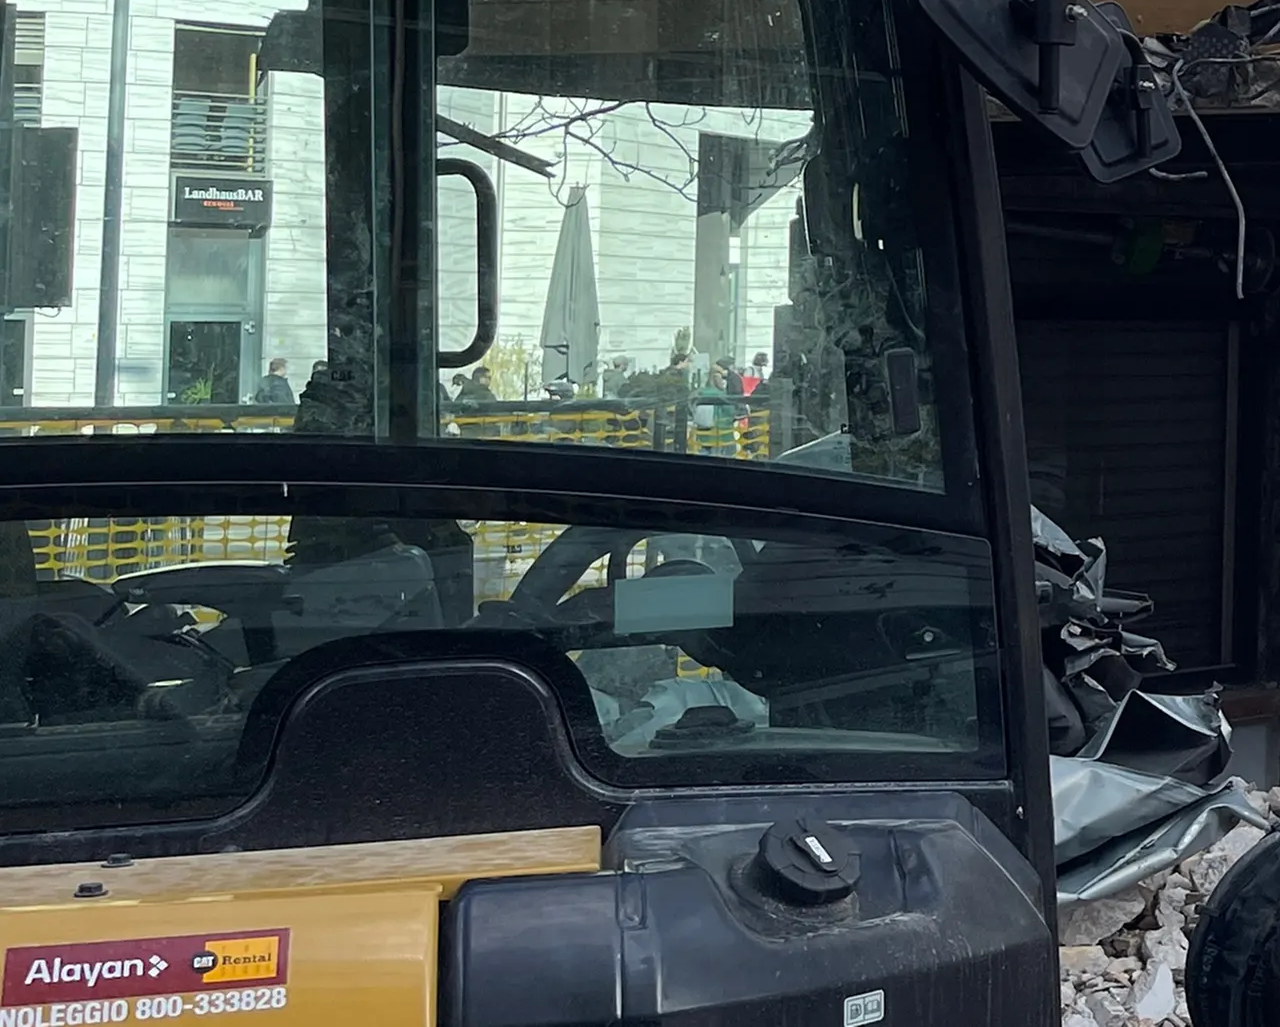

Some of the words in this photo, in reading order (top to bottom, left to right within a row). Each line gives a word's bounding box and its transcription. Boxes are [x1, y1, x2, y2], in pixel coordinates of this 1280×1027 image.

[184, 187, 263, 201] LandhausBAR
[25, 957, 144, 987] Alayan
[193, 956, 214, 970] CAT
[222, 952, 272, 966] Rental
[135, 987, 287, 1020] 800-333828
